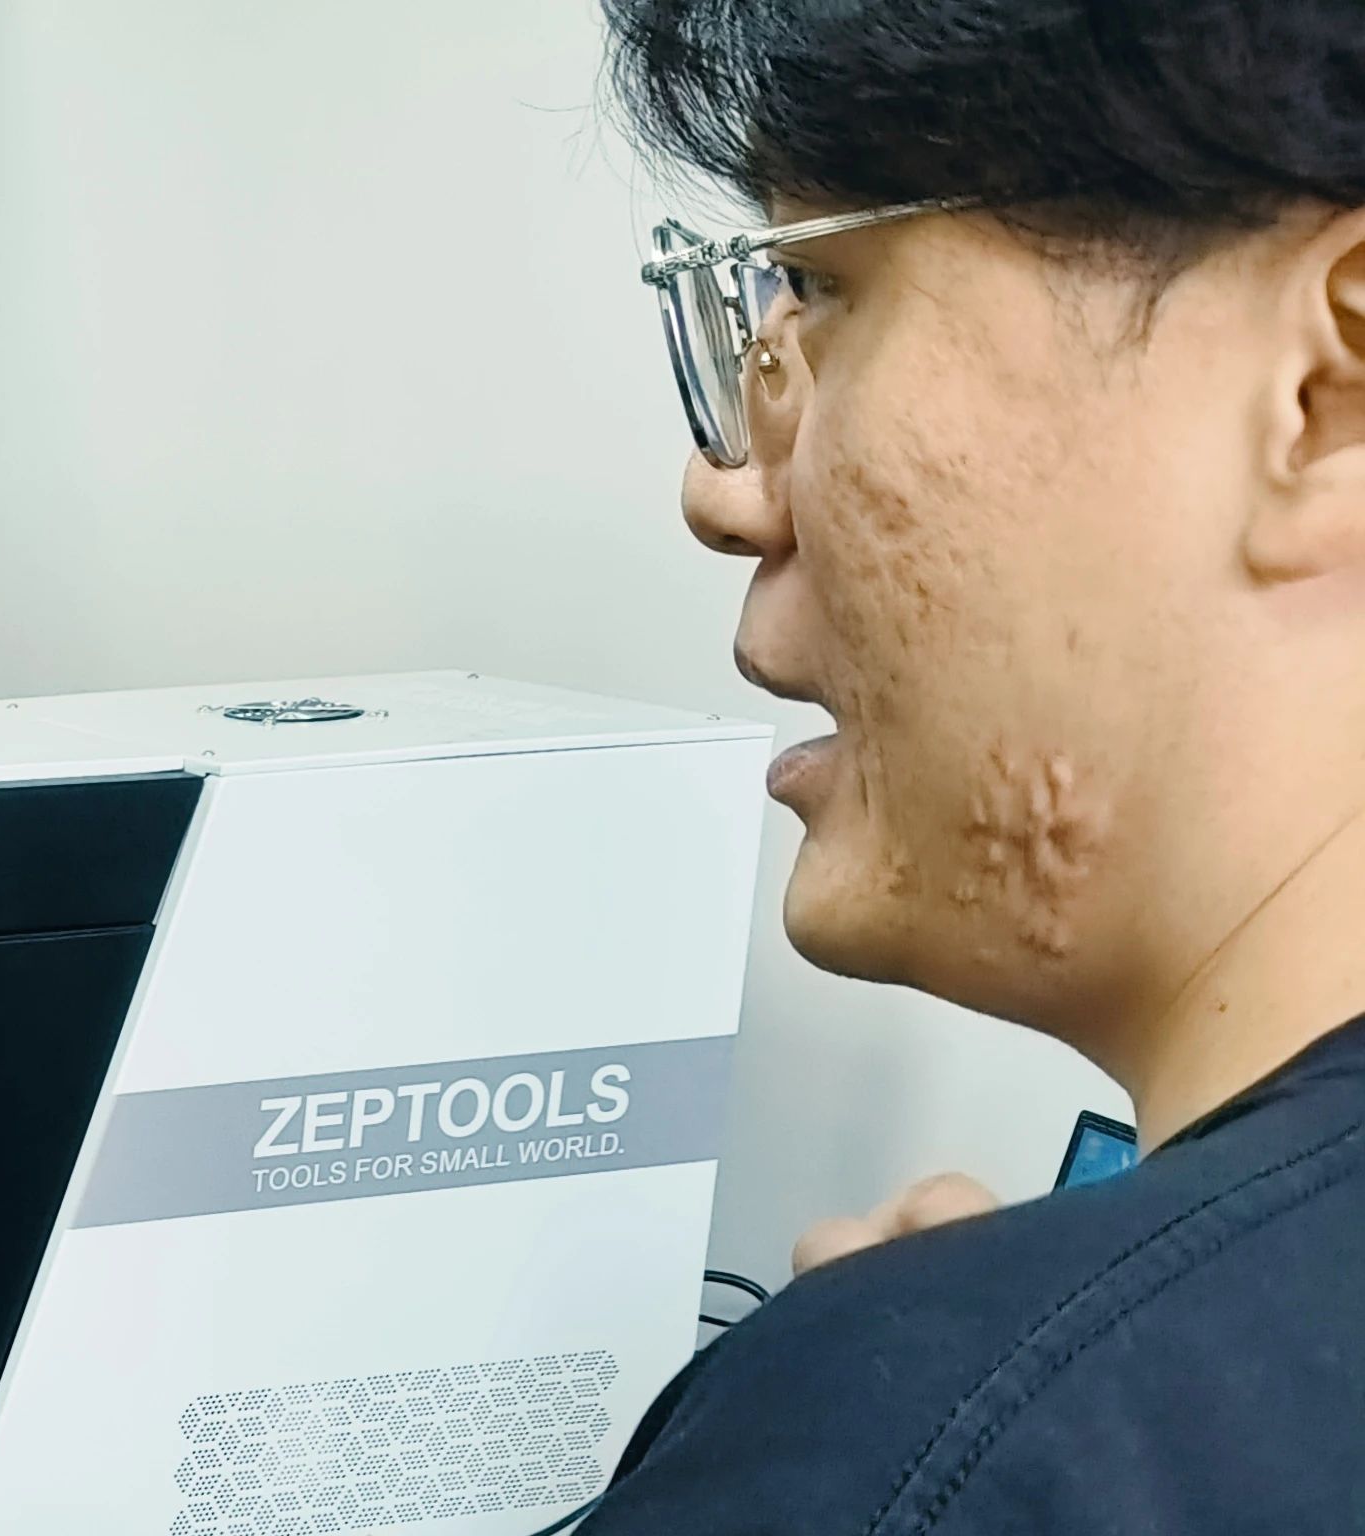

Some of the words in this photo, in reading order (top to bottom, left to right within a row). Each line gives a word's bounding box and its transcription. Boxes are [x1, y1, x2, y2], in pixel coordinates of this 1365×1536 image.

[253, 1064, 631, 1158] ZEPTOOLS
[252, 1160, 346, 1192] TOOLS
[354, 1153, 413, 1182] FOR
[420, 1144, 511, 1175] SMALL
[518, 1132, 625, 1164] WORLD.
